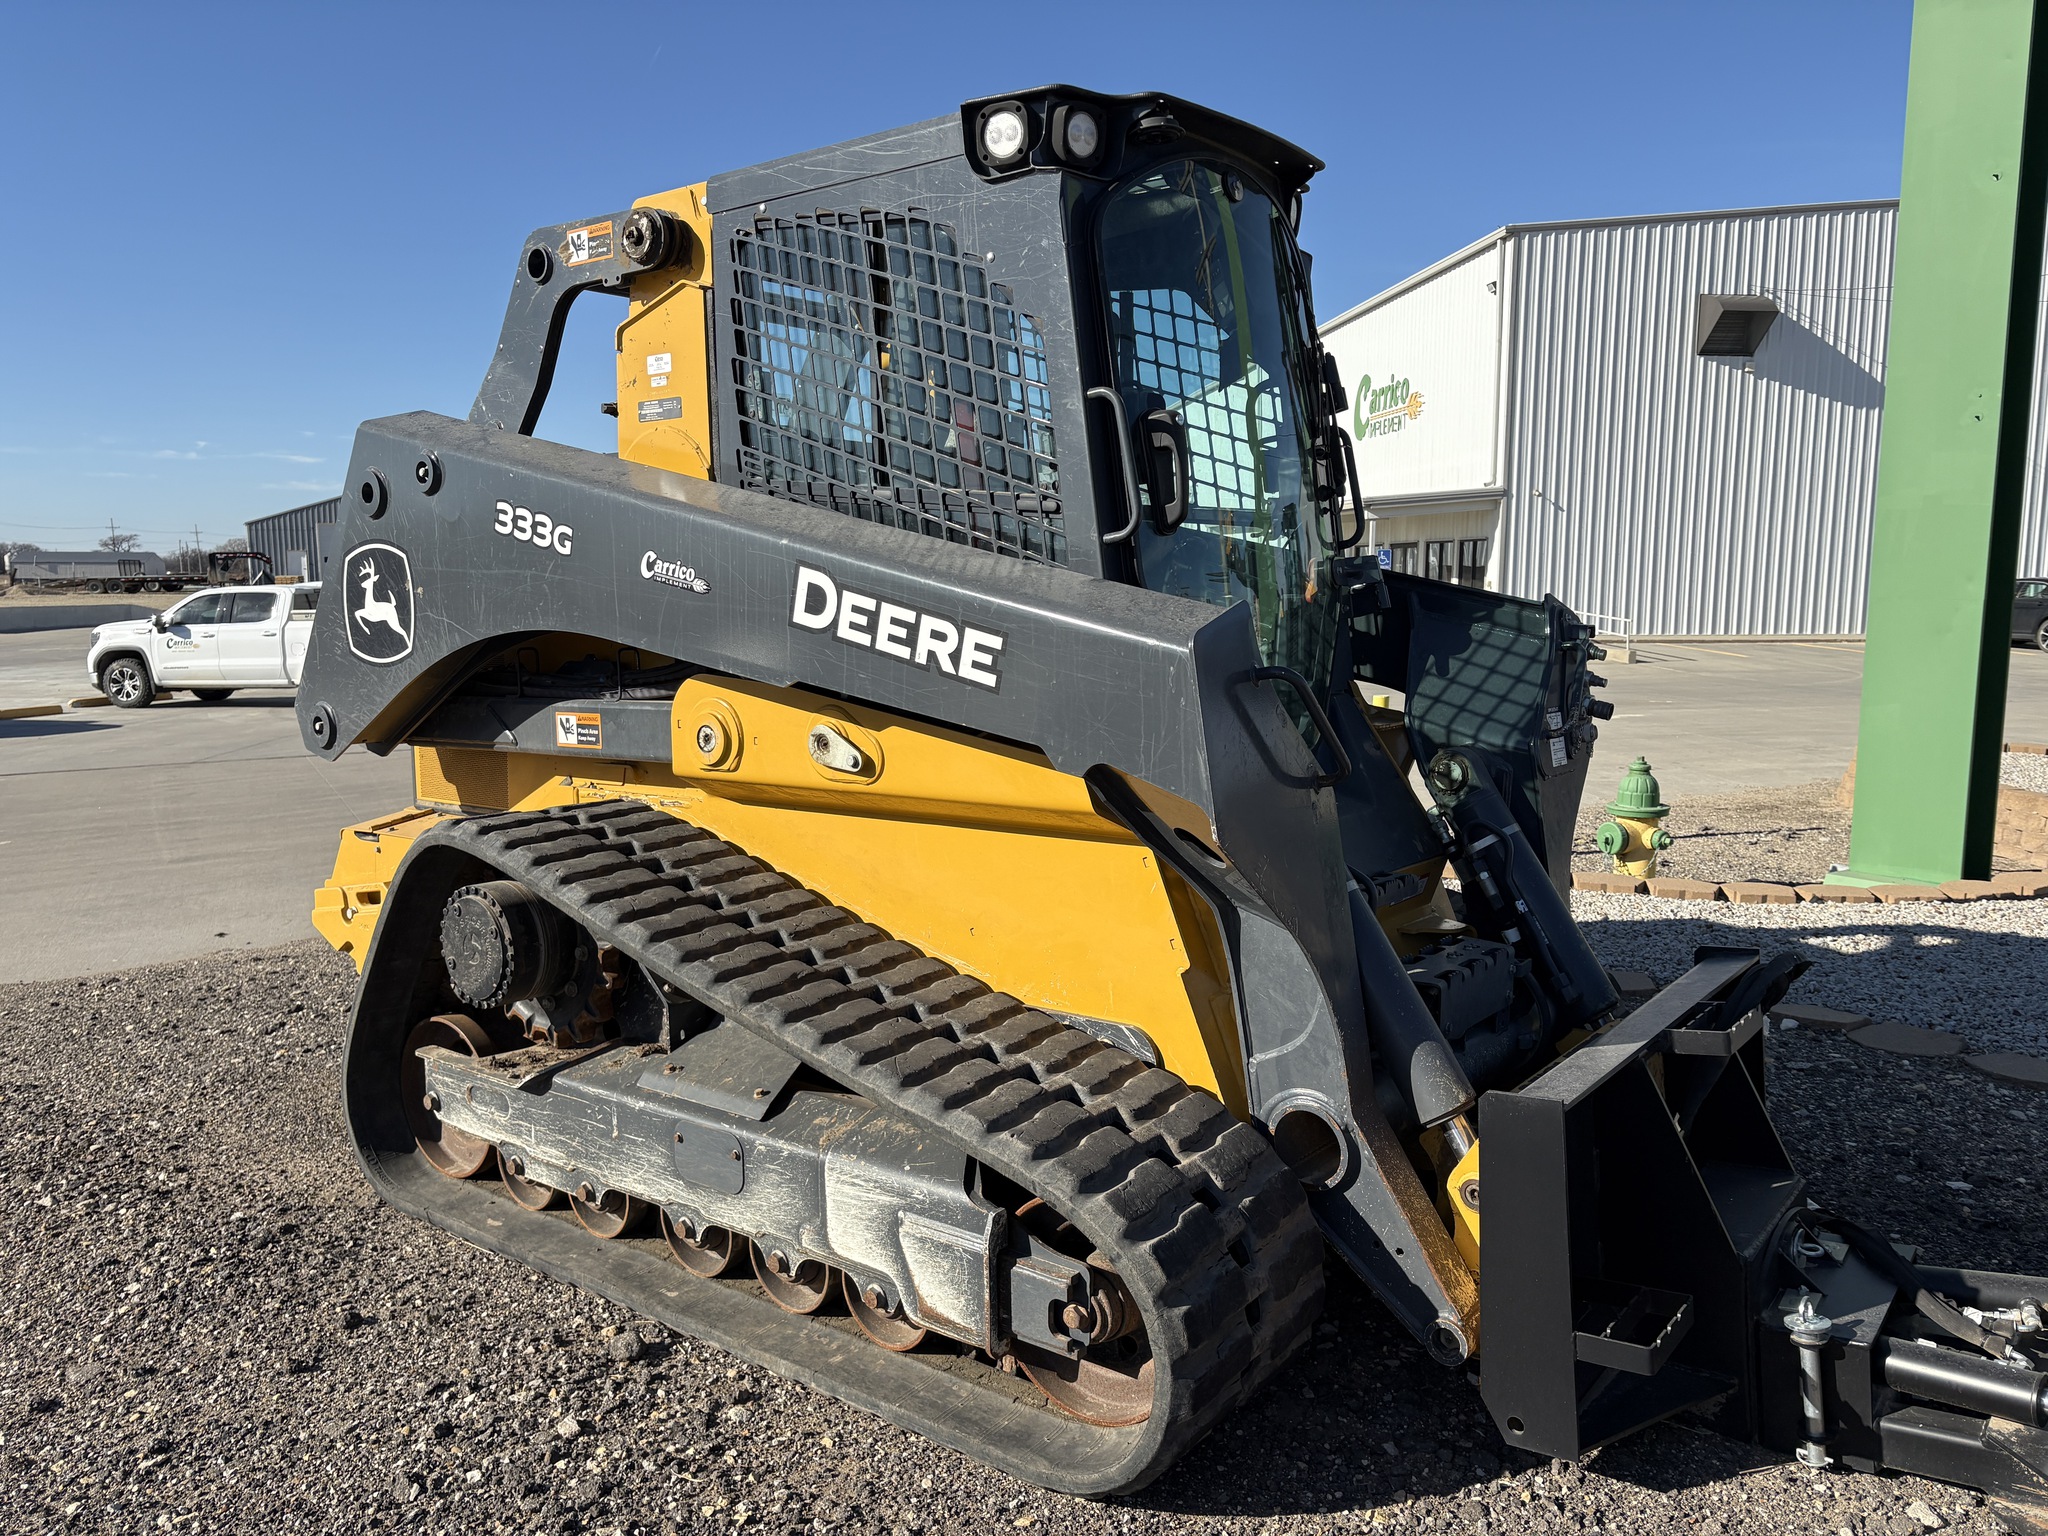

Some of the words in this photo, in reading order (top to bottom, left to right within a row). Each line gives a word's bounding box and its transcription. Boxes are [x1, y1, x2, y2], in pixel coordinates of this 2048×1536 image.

[1354, 373, 1410, 441] Carrico
[494, 501, 573, 556] 333G
[641, 551, 695, 580] Carrico
[654, 575, 692, 590] IMPLEMENT
[166, 638, 194, 649] Carrico
[793, 566, 1003, 688] DEERE
